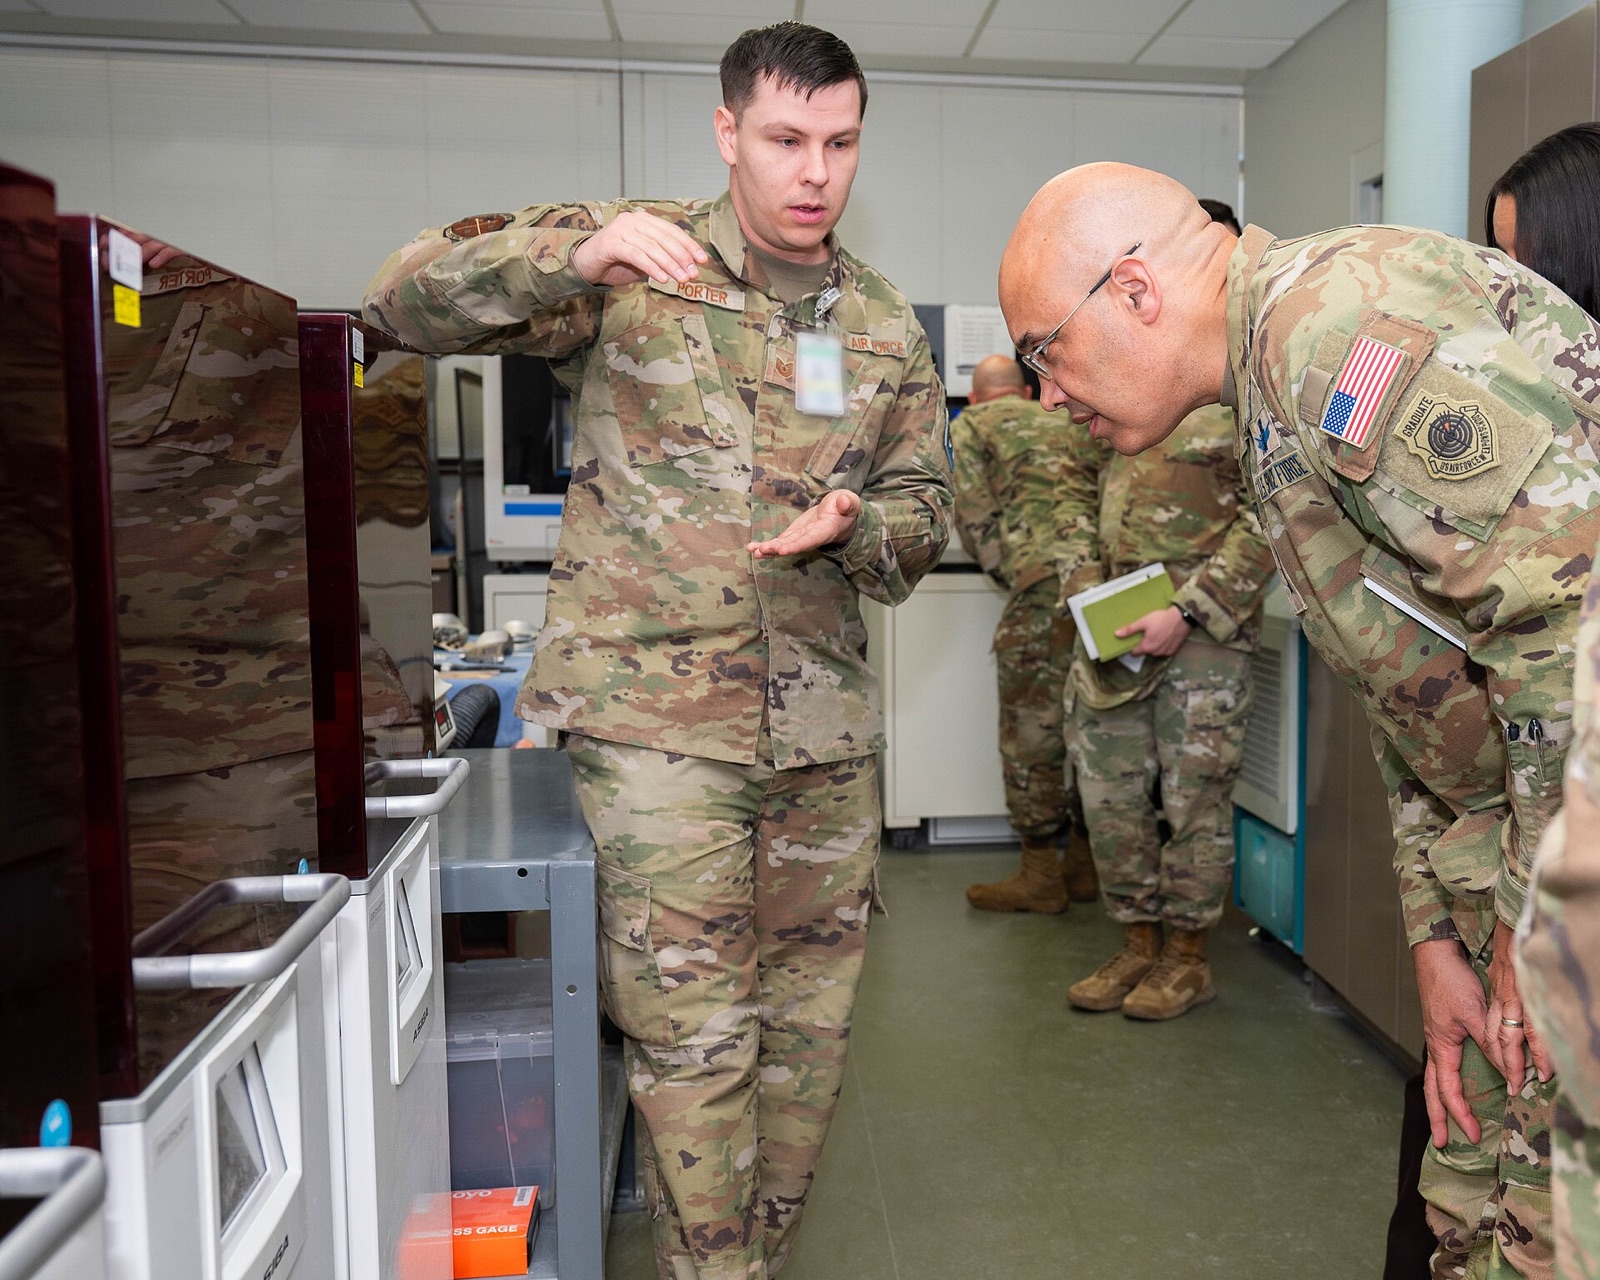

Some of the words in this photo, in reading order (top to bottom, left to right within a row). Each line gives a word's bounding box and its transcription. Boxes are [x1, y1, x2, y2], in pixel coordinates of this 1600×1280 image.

[677, 282, 728, 305] PORTER
[851, 337, 869, 350] AIR
[1402, 396, 1433, 438] GRADUATE
[1273, 453, 1308, 485] FORCE
[1460, 455, 1481, 472] FORCE
[452, 1189, 493, 1200] oyo
[452, 1227, 473, 1236] SS
[475, 1225, 519, 1235] GAGE
[263, 1234, 289, 1280] SIGA
